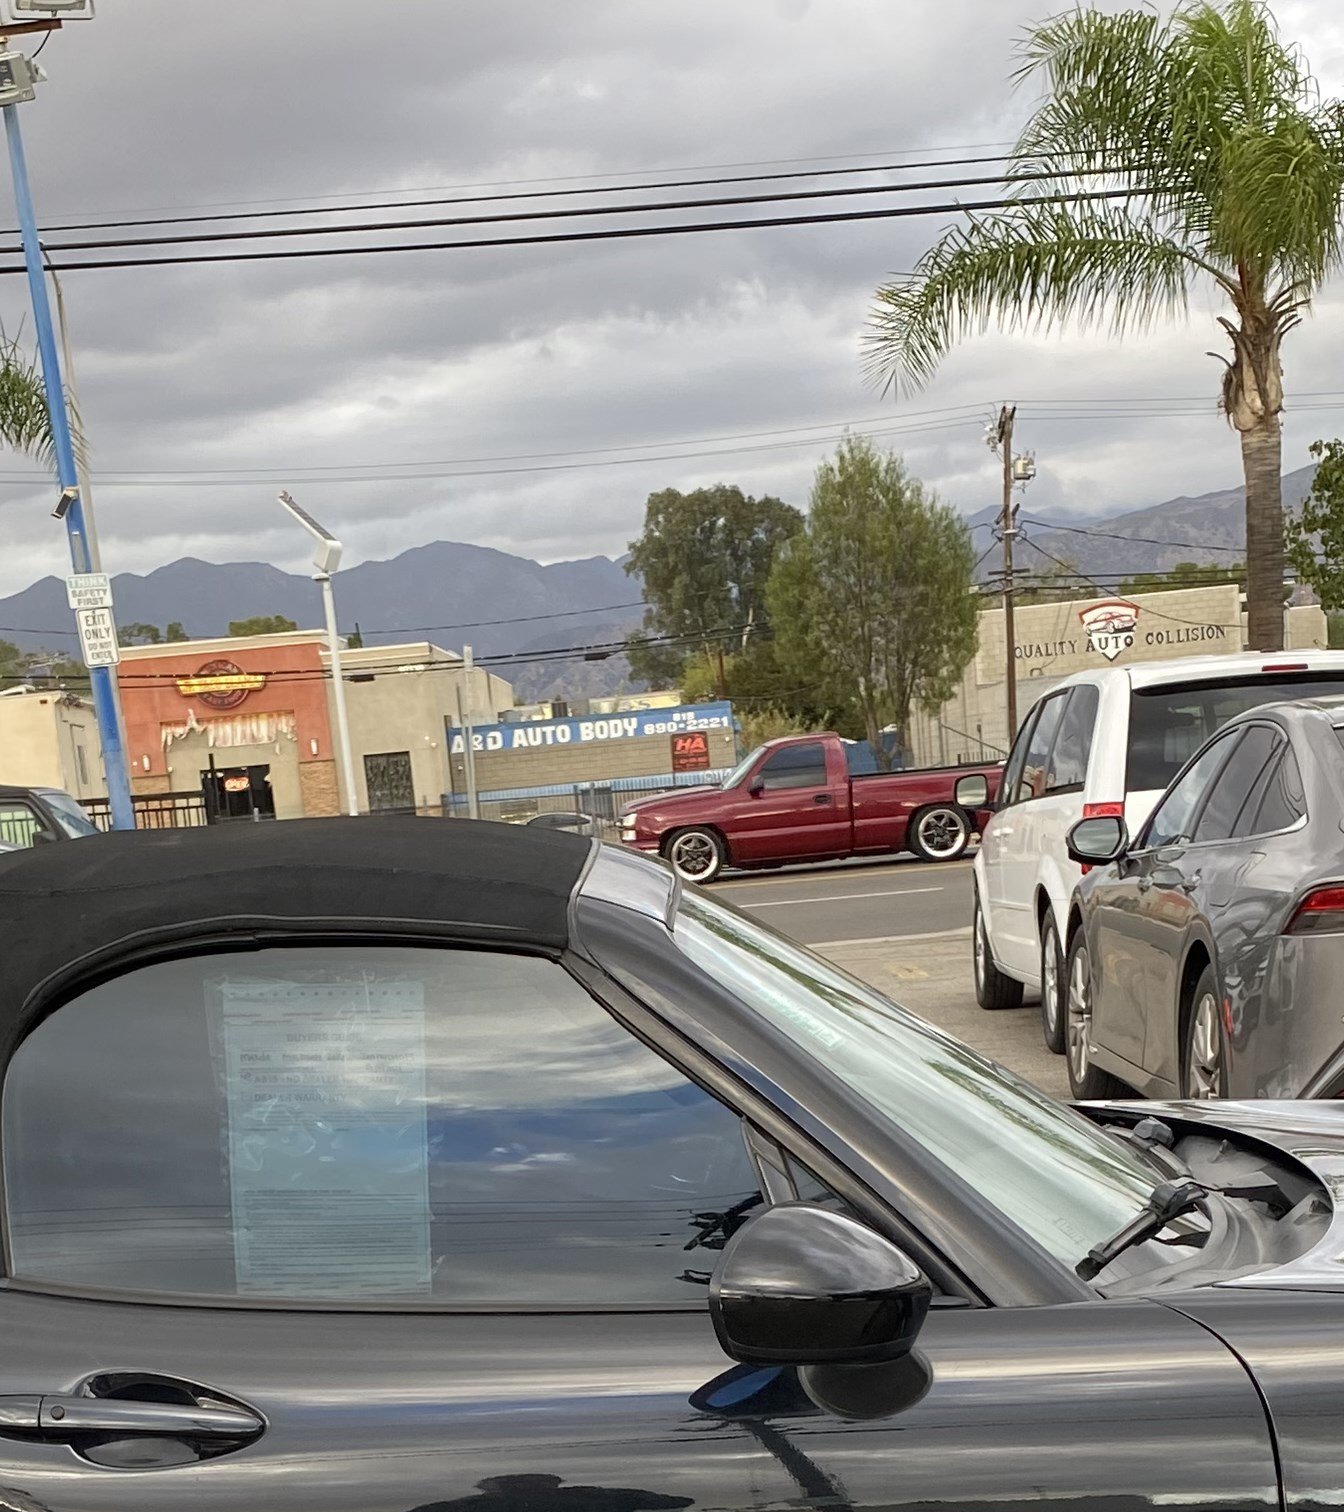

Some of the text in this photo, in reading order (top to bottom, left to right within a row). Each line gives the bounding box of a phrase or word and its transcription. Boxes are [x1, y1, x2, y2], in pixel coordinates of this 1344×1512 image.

[71, 588, 108, 598] SAFETY
[77, 597, 104, 607] FIRST
[85, 613, 106, 627] EXIT
[85, 627, 111, 641] ONLY
[88, 641, 112, 651] DO NOT
[1014, 625, 1226, 659] QUALITY AUTO COLLISION
[91, 650, 113, 660] ENTER
[450, 716, 729, 754] A&D AUTO BODY 890-2221
